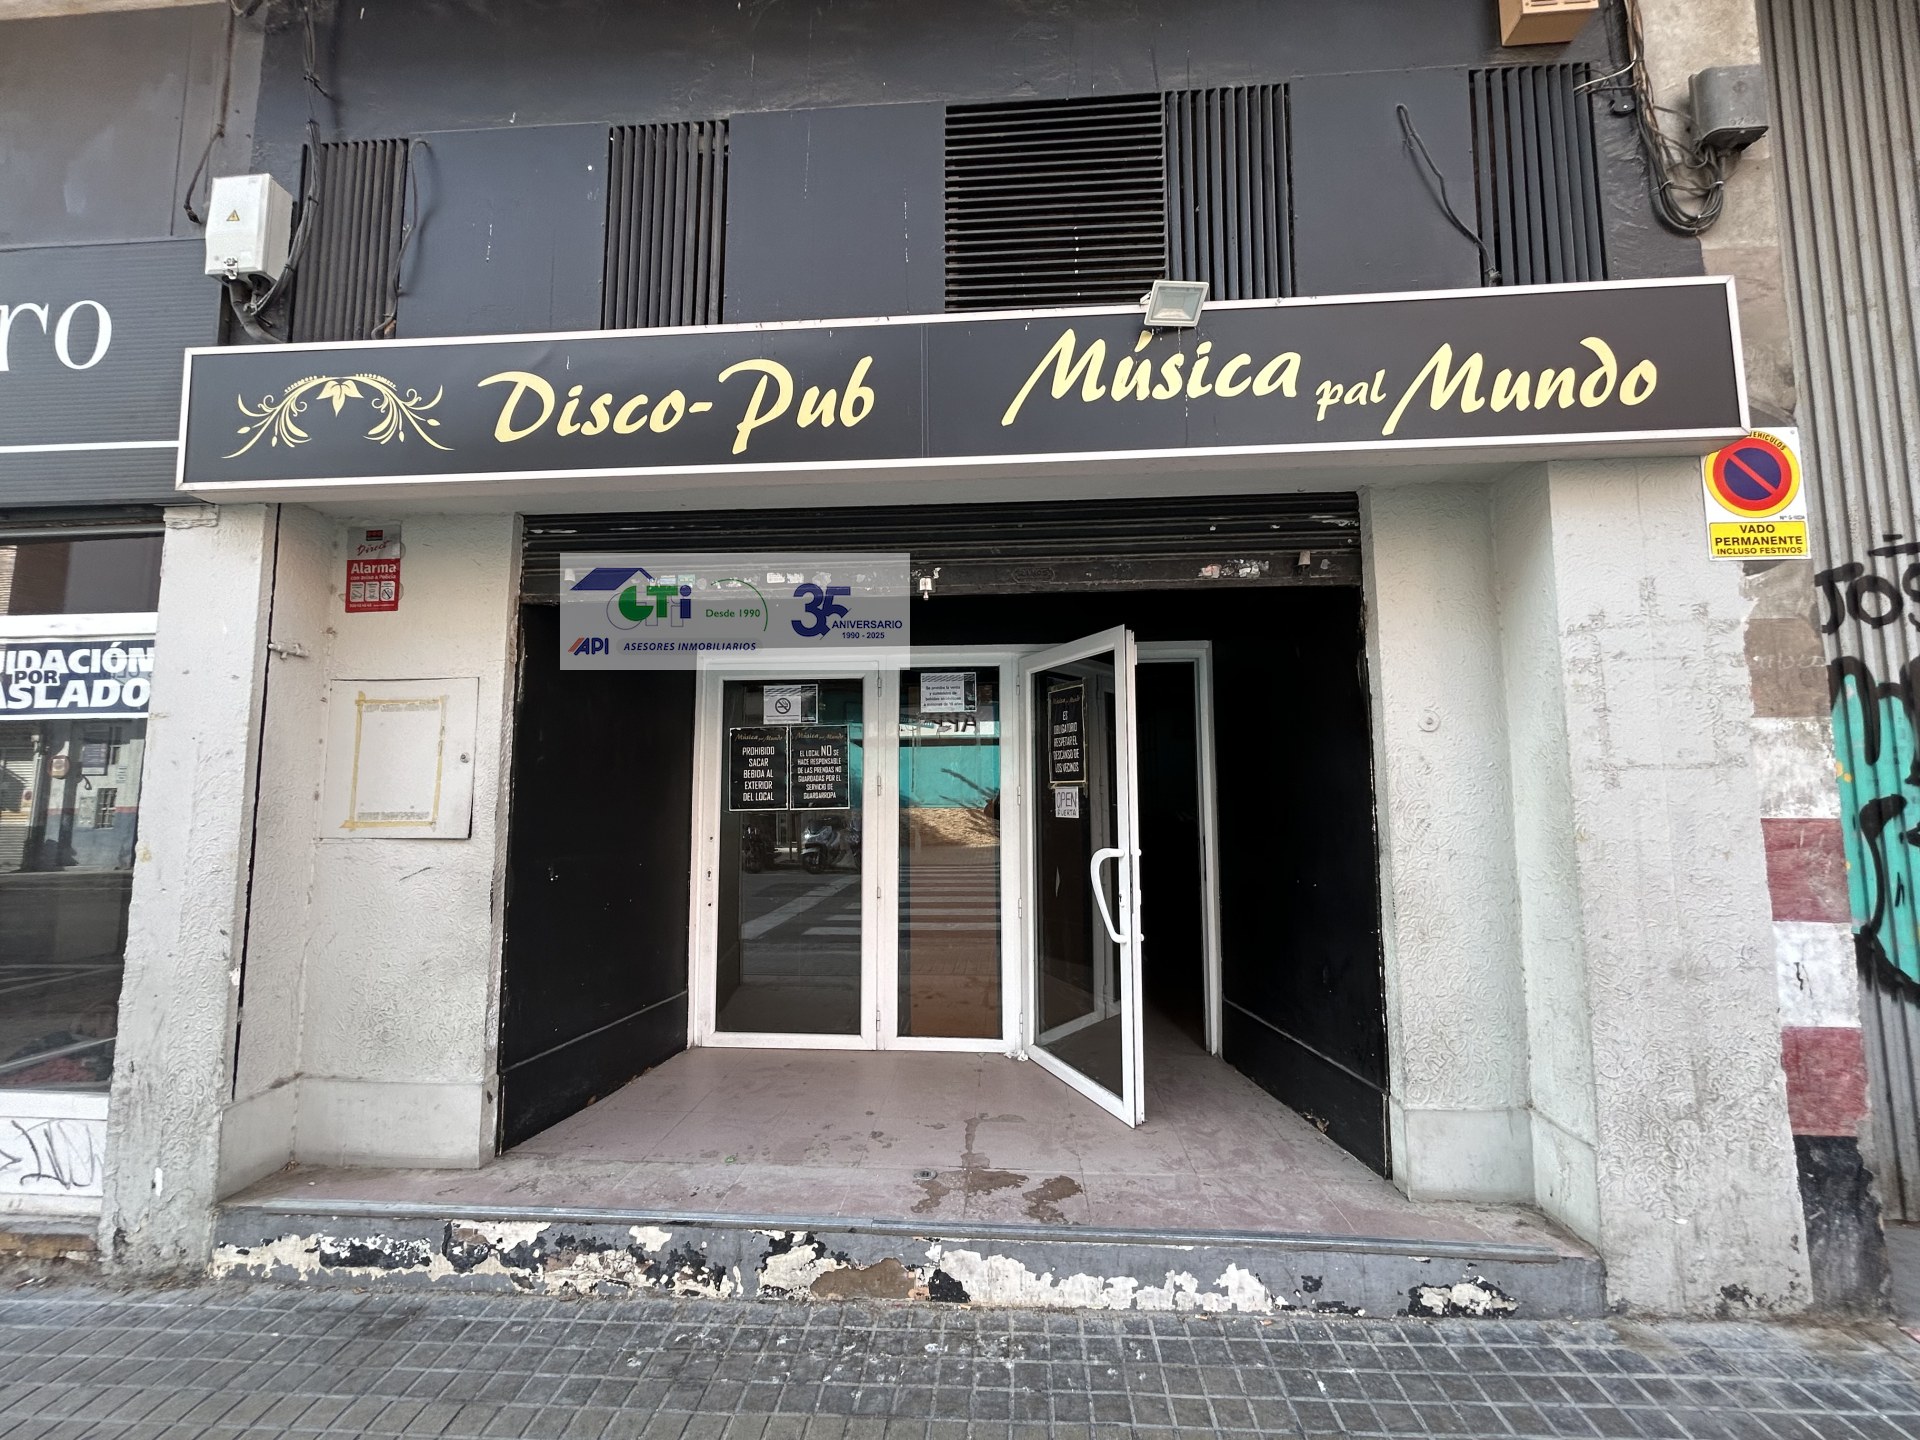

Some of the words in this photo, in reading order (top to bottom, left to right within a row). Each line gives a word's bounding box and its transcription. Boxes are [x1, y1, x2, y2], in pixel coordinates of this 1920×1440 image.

[1001, 328, 1301, 426] Música
[1315, 368, 1386, 422] pal
[1381, 336, 1657, 436] Mundo
[477, 371, 713, 443] Disco-
[718, 355, 875, 455] Pub
[1739, 524, 1775, 533] VADO
[1714, 536, 1803, 546] PERMANENTE
[350, 562, 397, 574] Alarma
[0, 641, 155, 675] IDACIÓN
[14, 670, 58, 685] POR
[0, 678, 150, 710] SLADO
[742, 746, 775, 756] PROHIBIDO
[820, 745, 832, 756] NO
[748, 757, 769, 767] SACAR
[809, 757, 841, 765] RESPONSABLE
[743, 769, 765, 779] BEBIDA
[766, 769, 774, 778] AL
[797, 766, 804, 774] DE
[804, 766, 813, 774] LAS
[825, 774, 836, 782] POR
[835, 774, 842, 782] EL
[744, 780, 773, 790] EXTERIOR
[805, 783, 827, 791] SERVICIO
[826, 783, 834, 791] DE
[742, 792, 755, 802] DEL
[755, 792, 775, 801] LOCAL
[1056, 791, 1077, 809] OPEN
